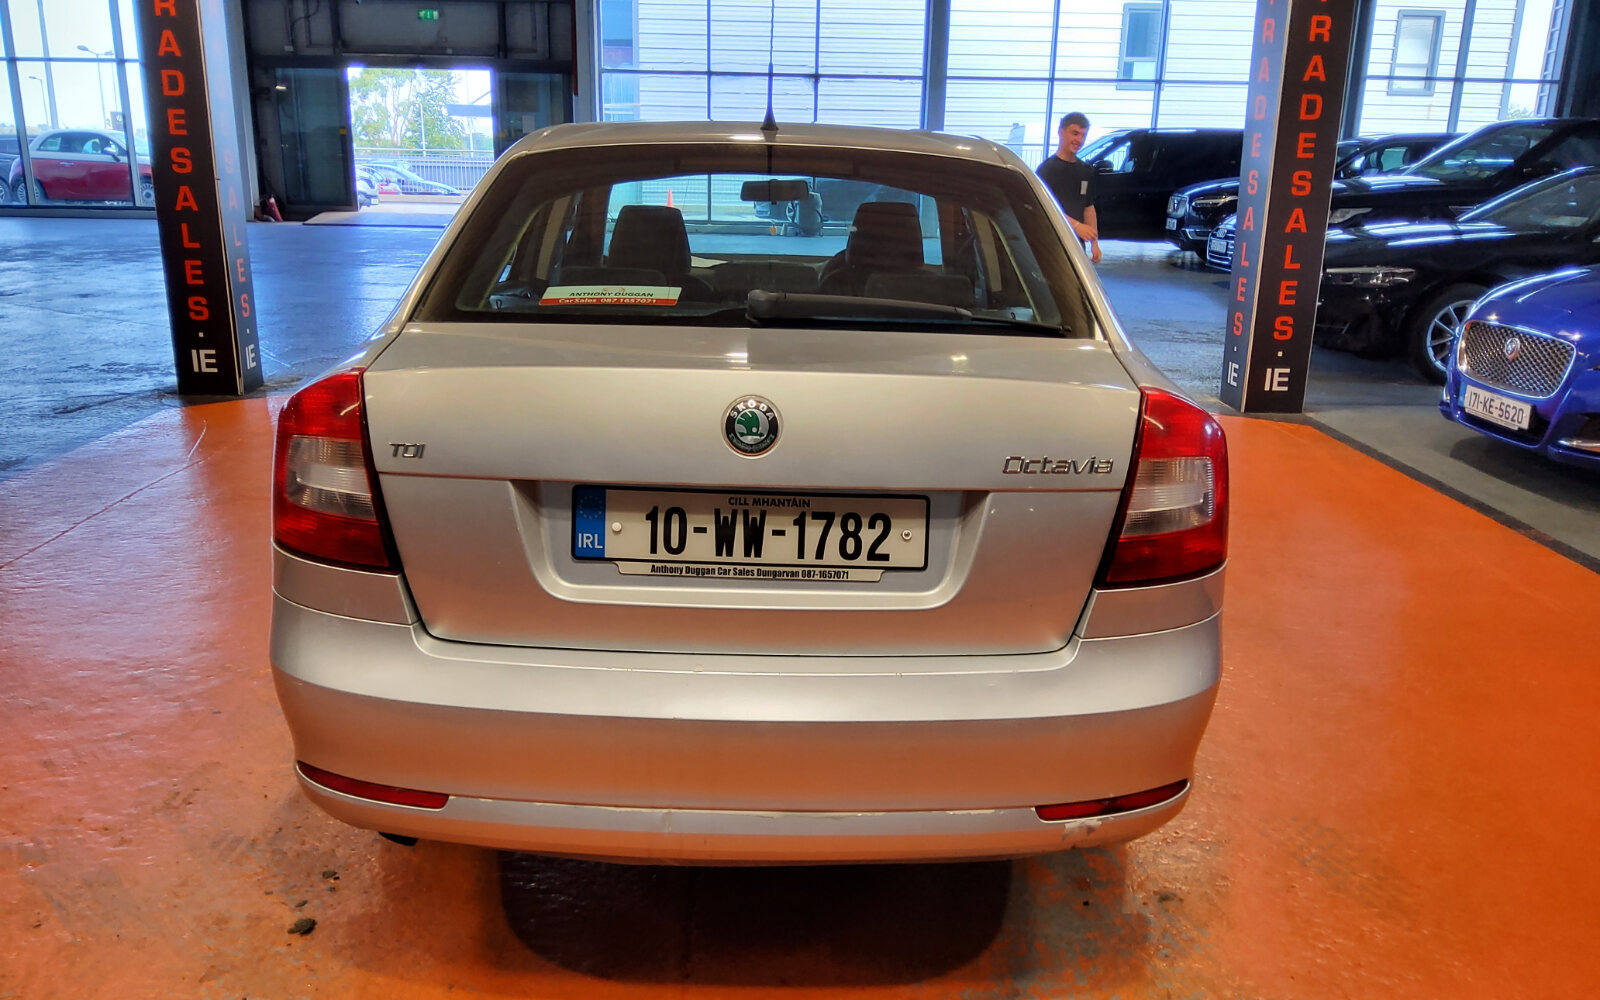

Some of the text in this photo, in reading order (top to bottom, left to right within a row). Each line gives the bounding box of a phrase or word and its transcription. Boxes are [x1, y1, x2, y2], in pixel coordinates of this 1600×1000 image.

[1227, 0, 1276, 387] RADESALES.IE
[1264, 0, 1332, 391] RADESALES.IE
[1468, 391, 1524, 424] 171-KE-5620
[389, 442, 426, 459] TDI
[1003, 455, 1114, 474] Octavia
[728, 496, 748, 506] CILL
[578, 533, 604, 549] IRL
[645, 505, 892, 562] 10-WW-1782
[650, 564, 849, 580] Anthony Duggan Car Sales Dungarvan 087-1657071
